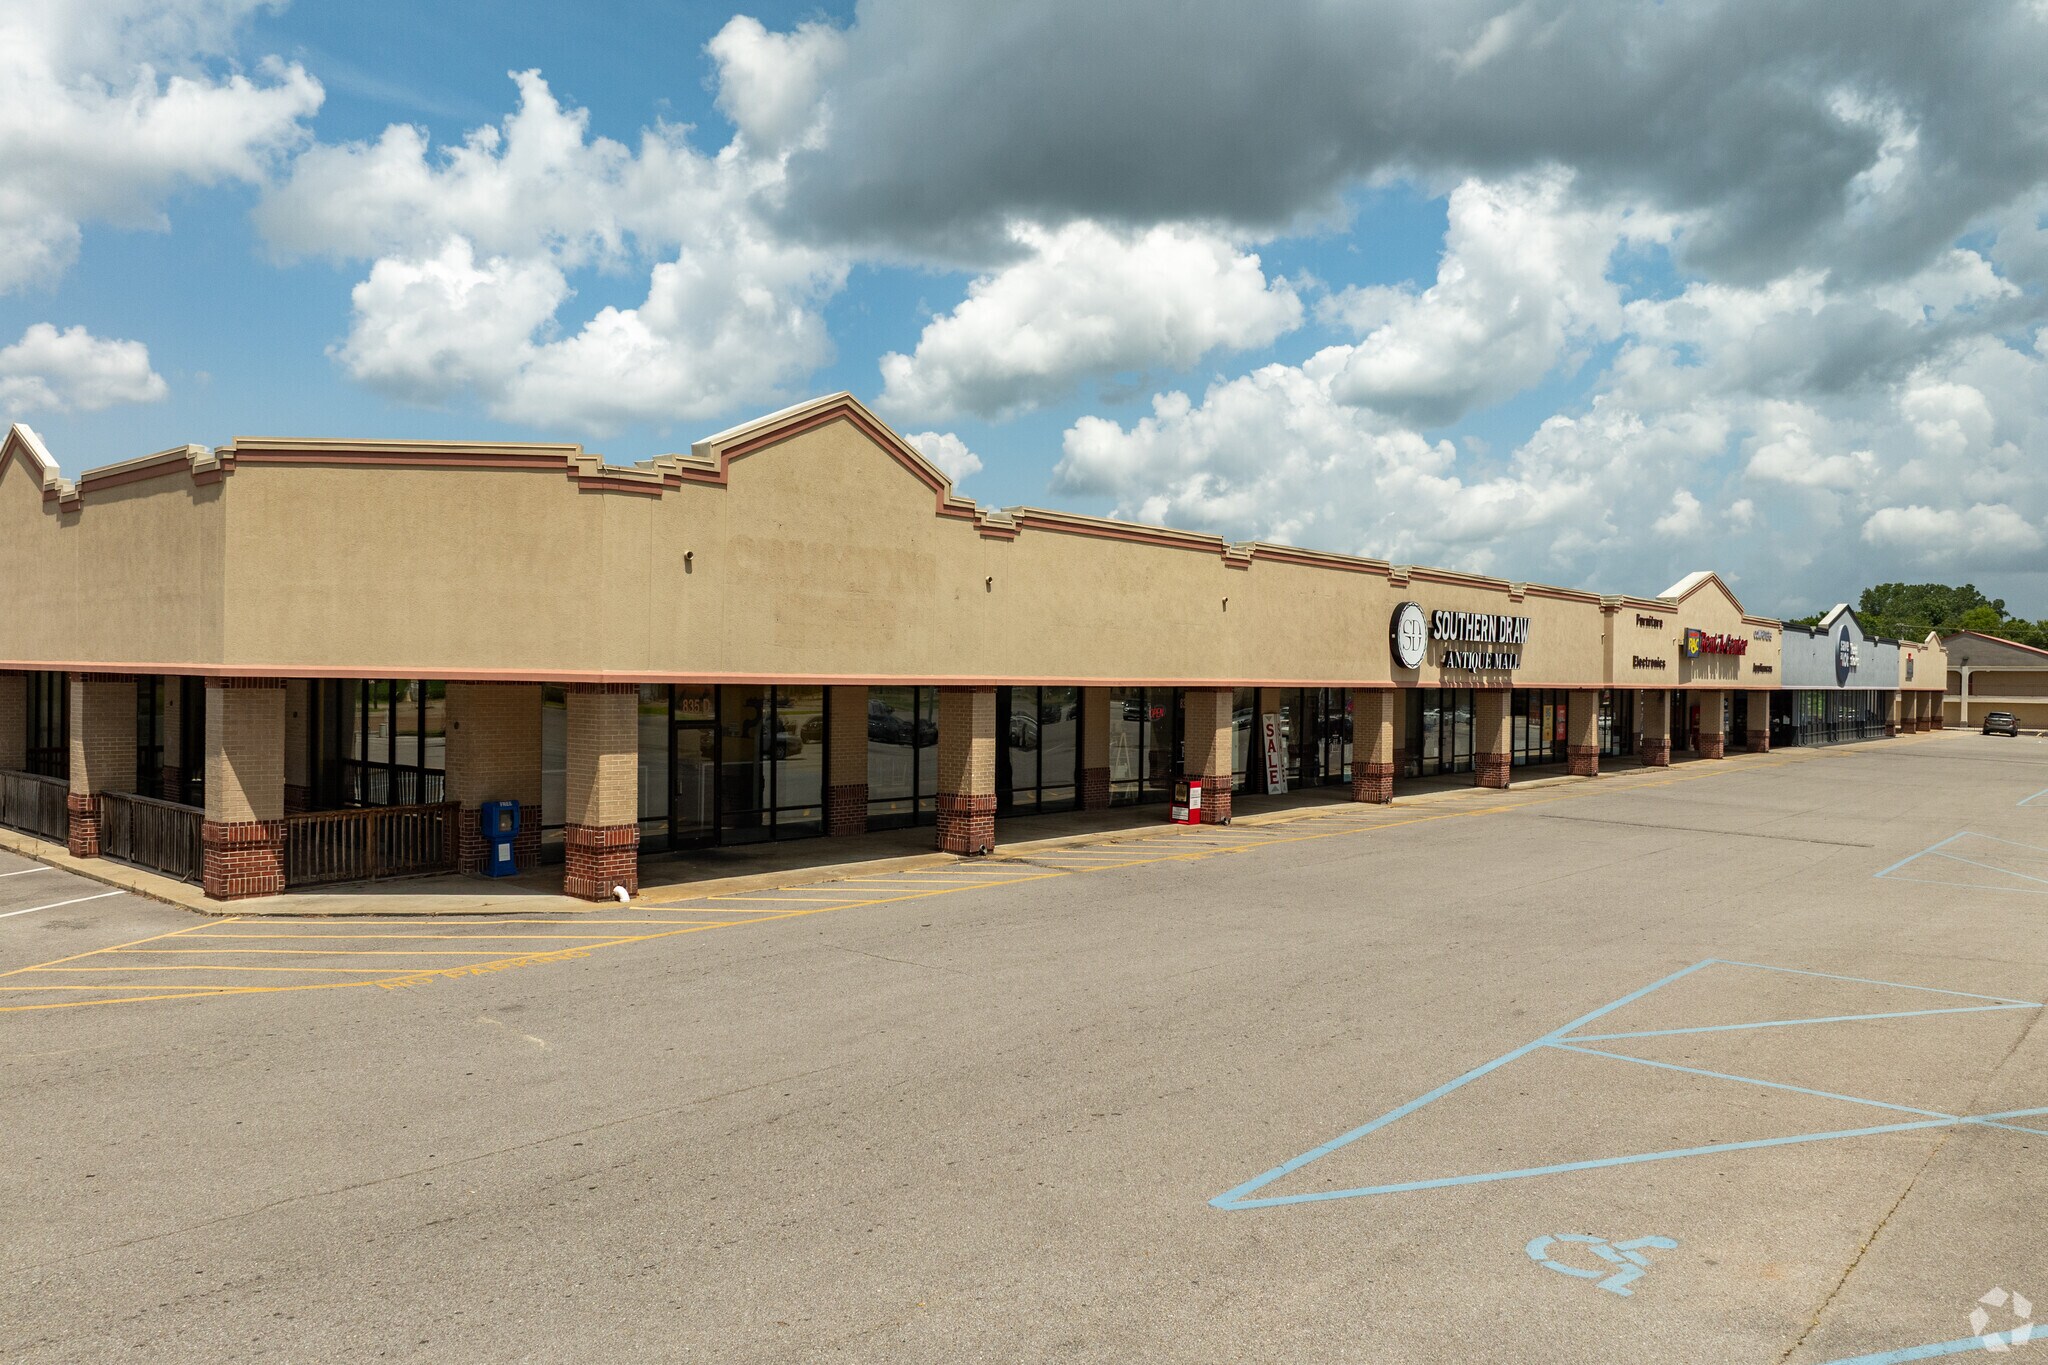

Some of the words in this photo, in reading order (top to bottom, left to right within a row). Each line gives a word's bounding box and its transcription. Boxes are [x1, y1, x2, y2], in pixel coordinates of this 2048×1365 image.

[1434, 610, 1497, 642] SOUTHERN
[1498, 617, 1531, 644] DRAW
[1636, 614, 1663, 629] Furniture
[1403, 619, 1422, 652] SD
[1446, 651, 1492, 674] ANTIQUE
[1494, 653, 1520, 670] MALL
[1632, 655, 1666, 671] Electronics
[682, 699, 700, 713] 835
[1266, 723, 1279, 784] SALE
